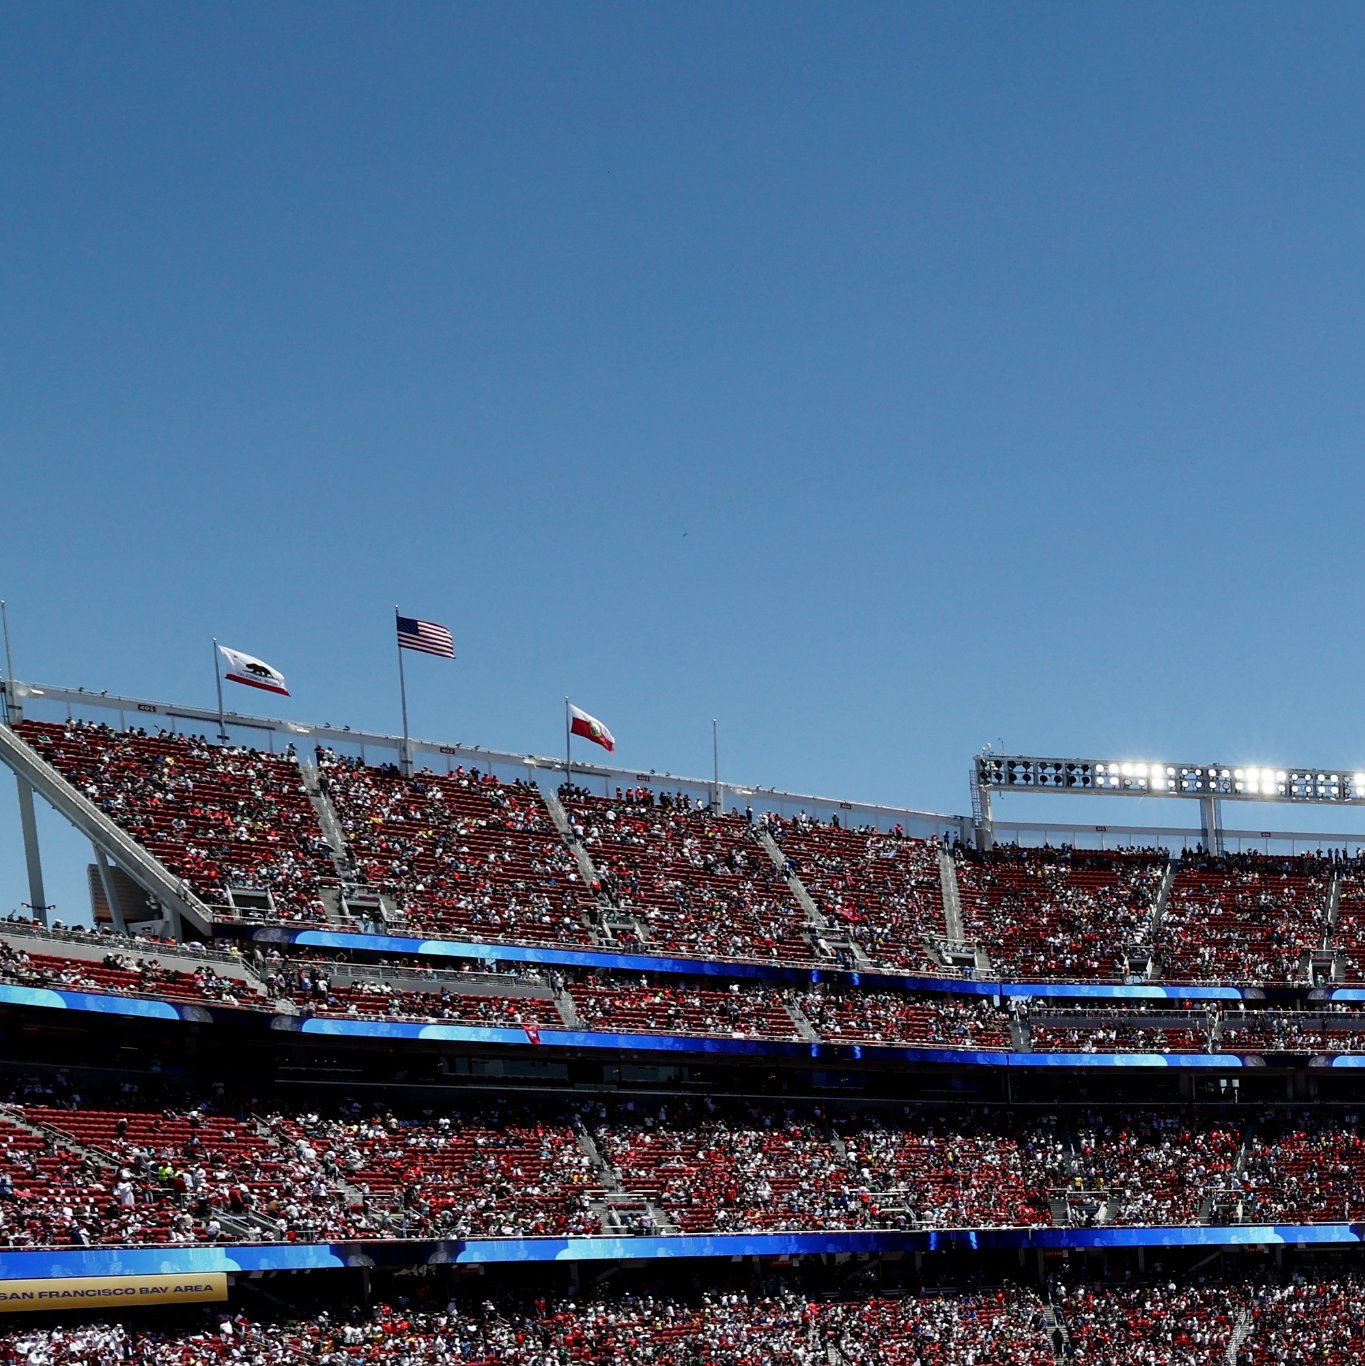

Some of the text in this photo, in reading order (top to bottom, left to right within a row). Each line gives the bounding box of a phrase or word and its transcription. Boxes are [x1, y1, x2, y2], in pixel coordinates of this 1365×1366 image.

[0, 1284, 214, 1301] SAN FRANCISCO BAY AREA
